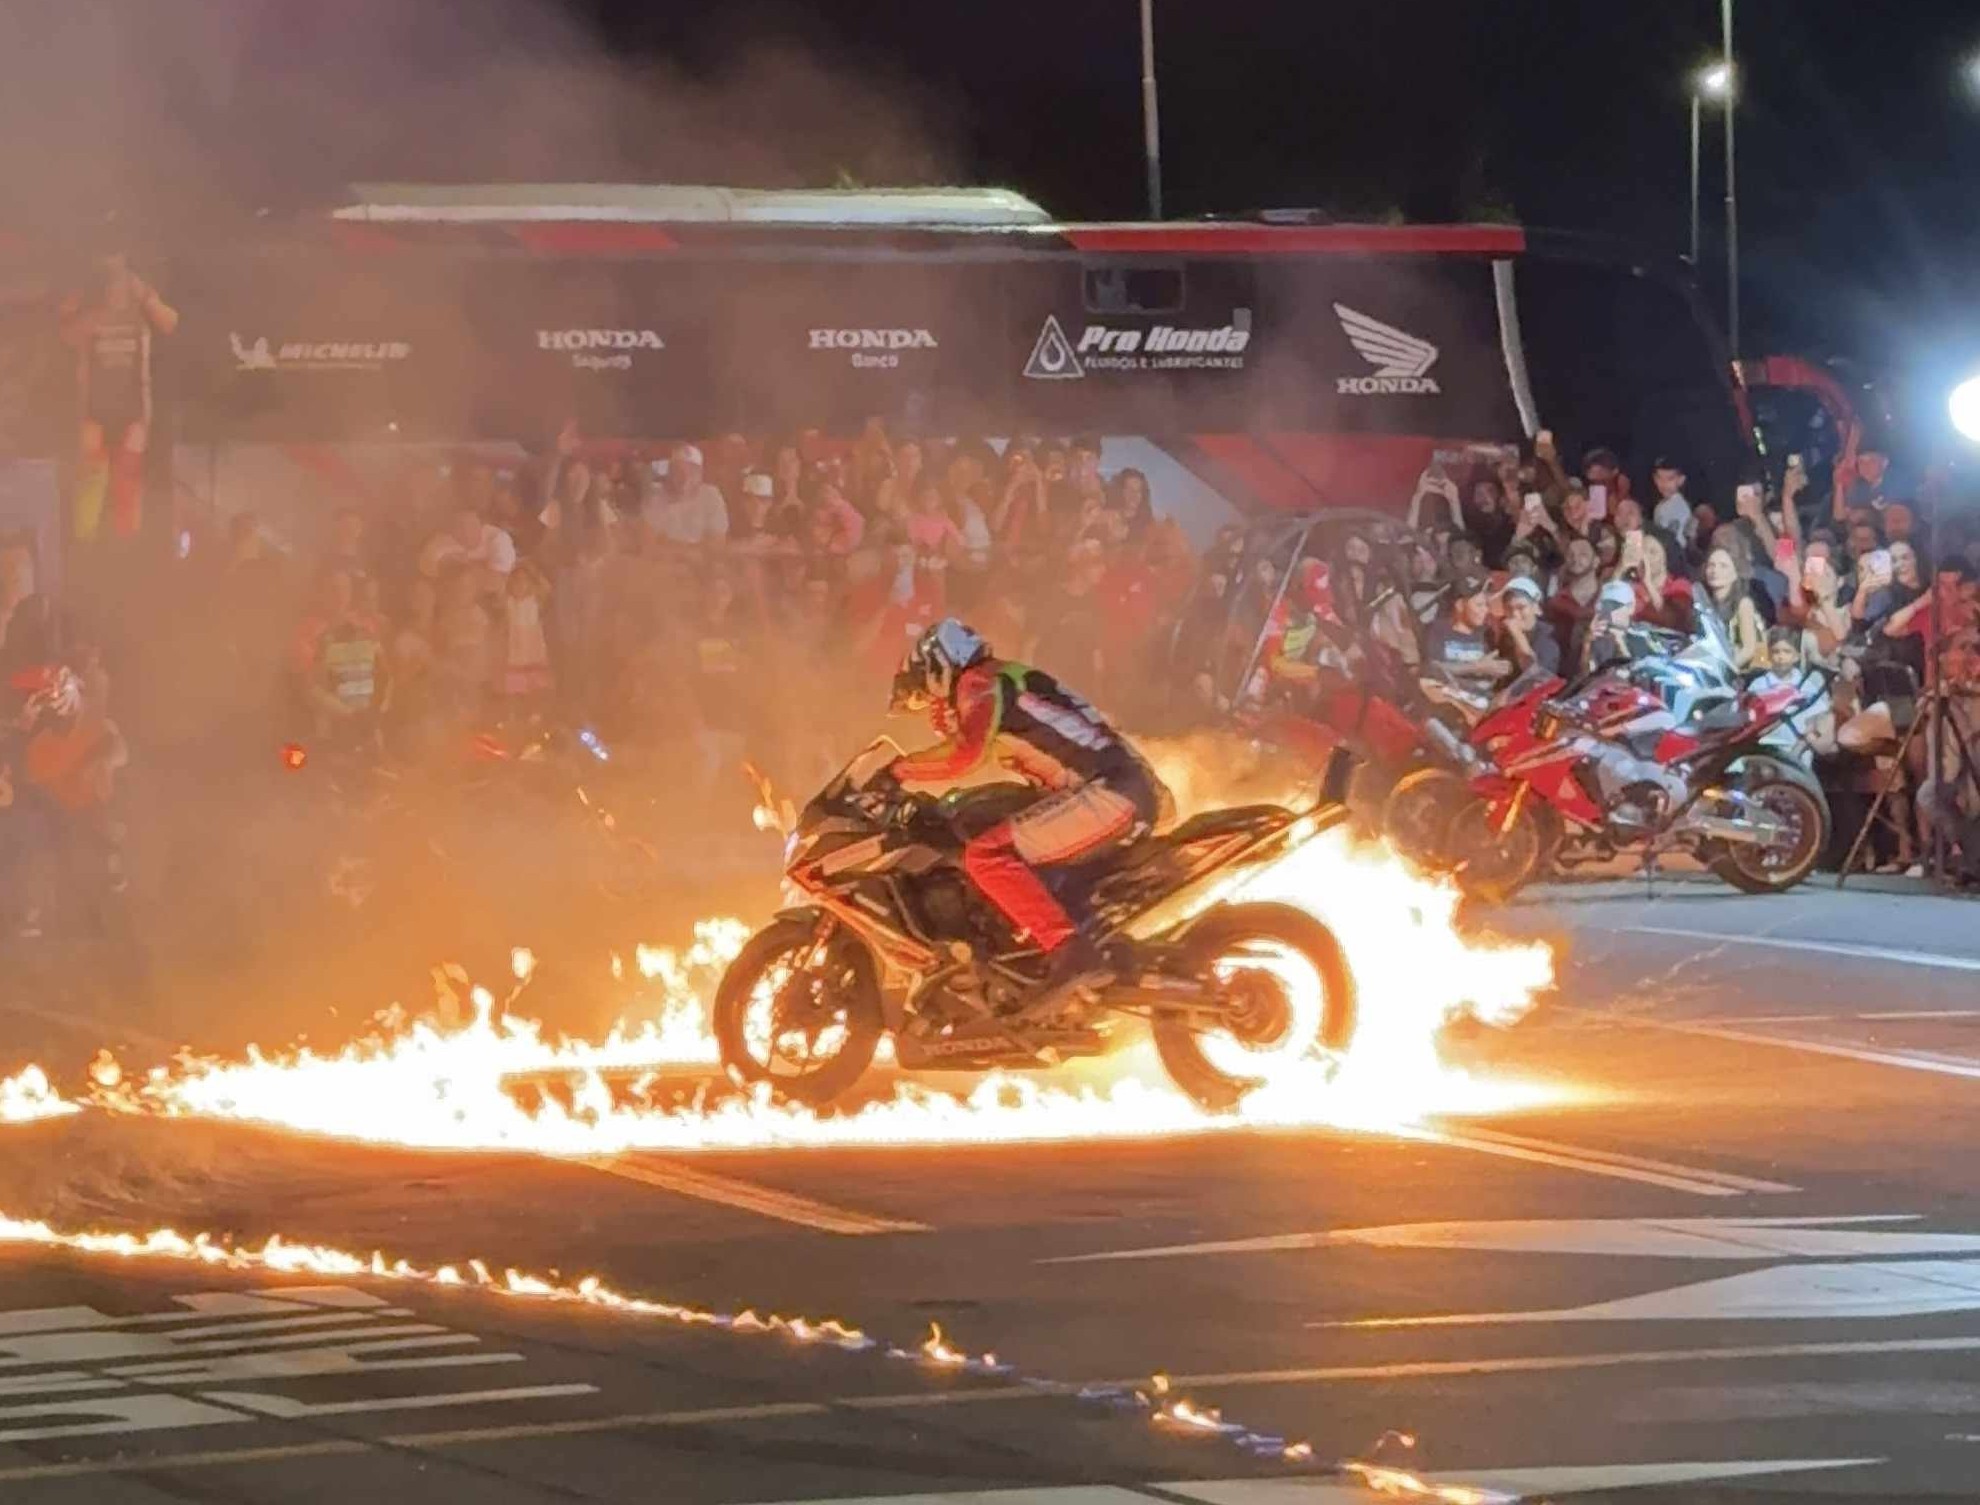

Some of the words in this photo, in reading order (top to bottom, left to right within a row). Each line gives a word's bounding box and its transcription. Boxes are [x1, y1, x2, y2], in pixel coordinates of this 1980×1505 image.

[537, 329, 664, 349] HONDA
[808, 329, 938, 349] HONDA
[1077, 326, 1142, 351] Pro
[1144, 325, 1250, 351] Honda
[1337, 377, 1441, 394] HONDA
[920, 1037, 1015, 1057] HONDA
